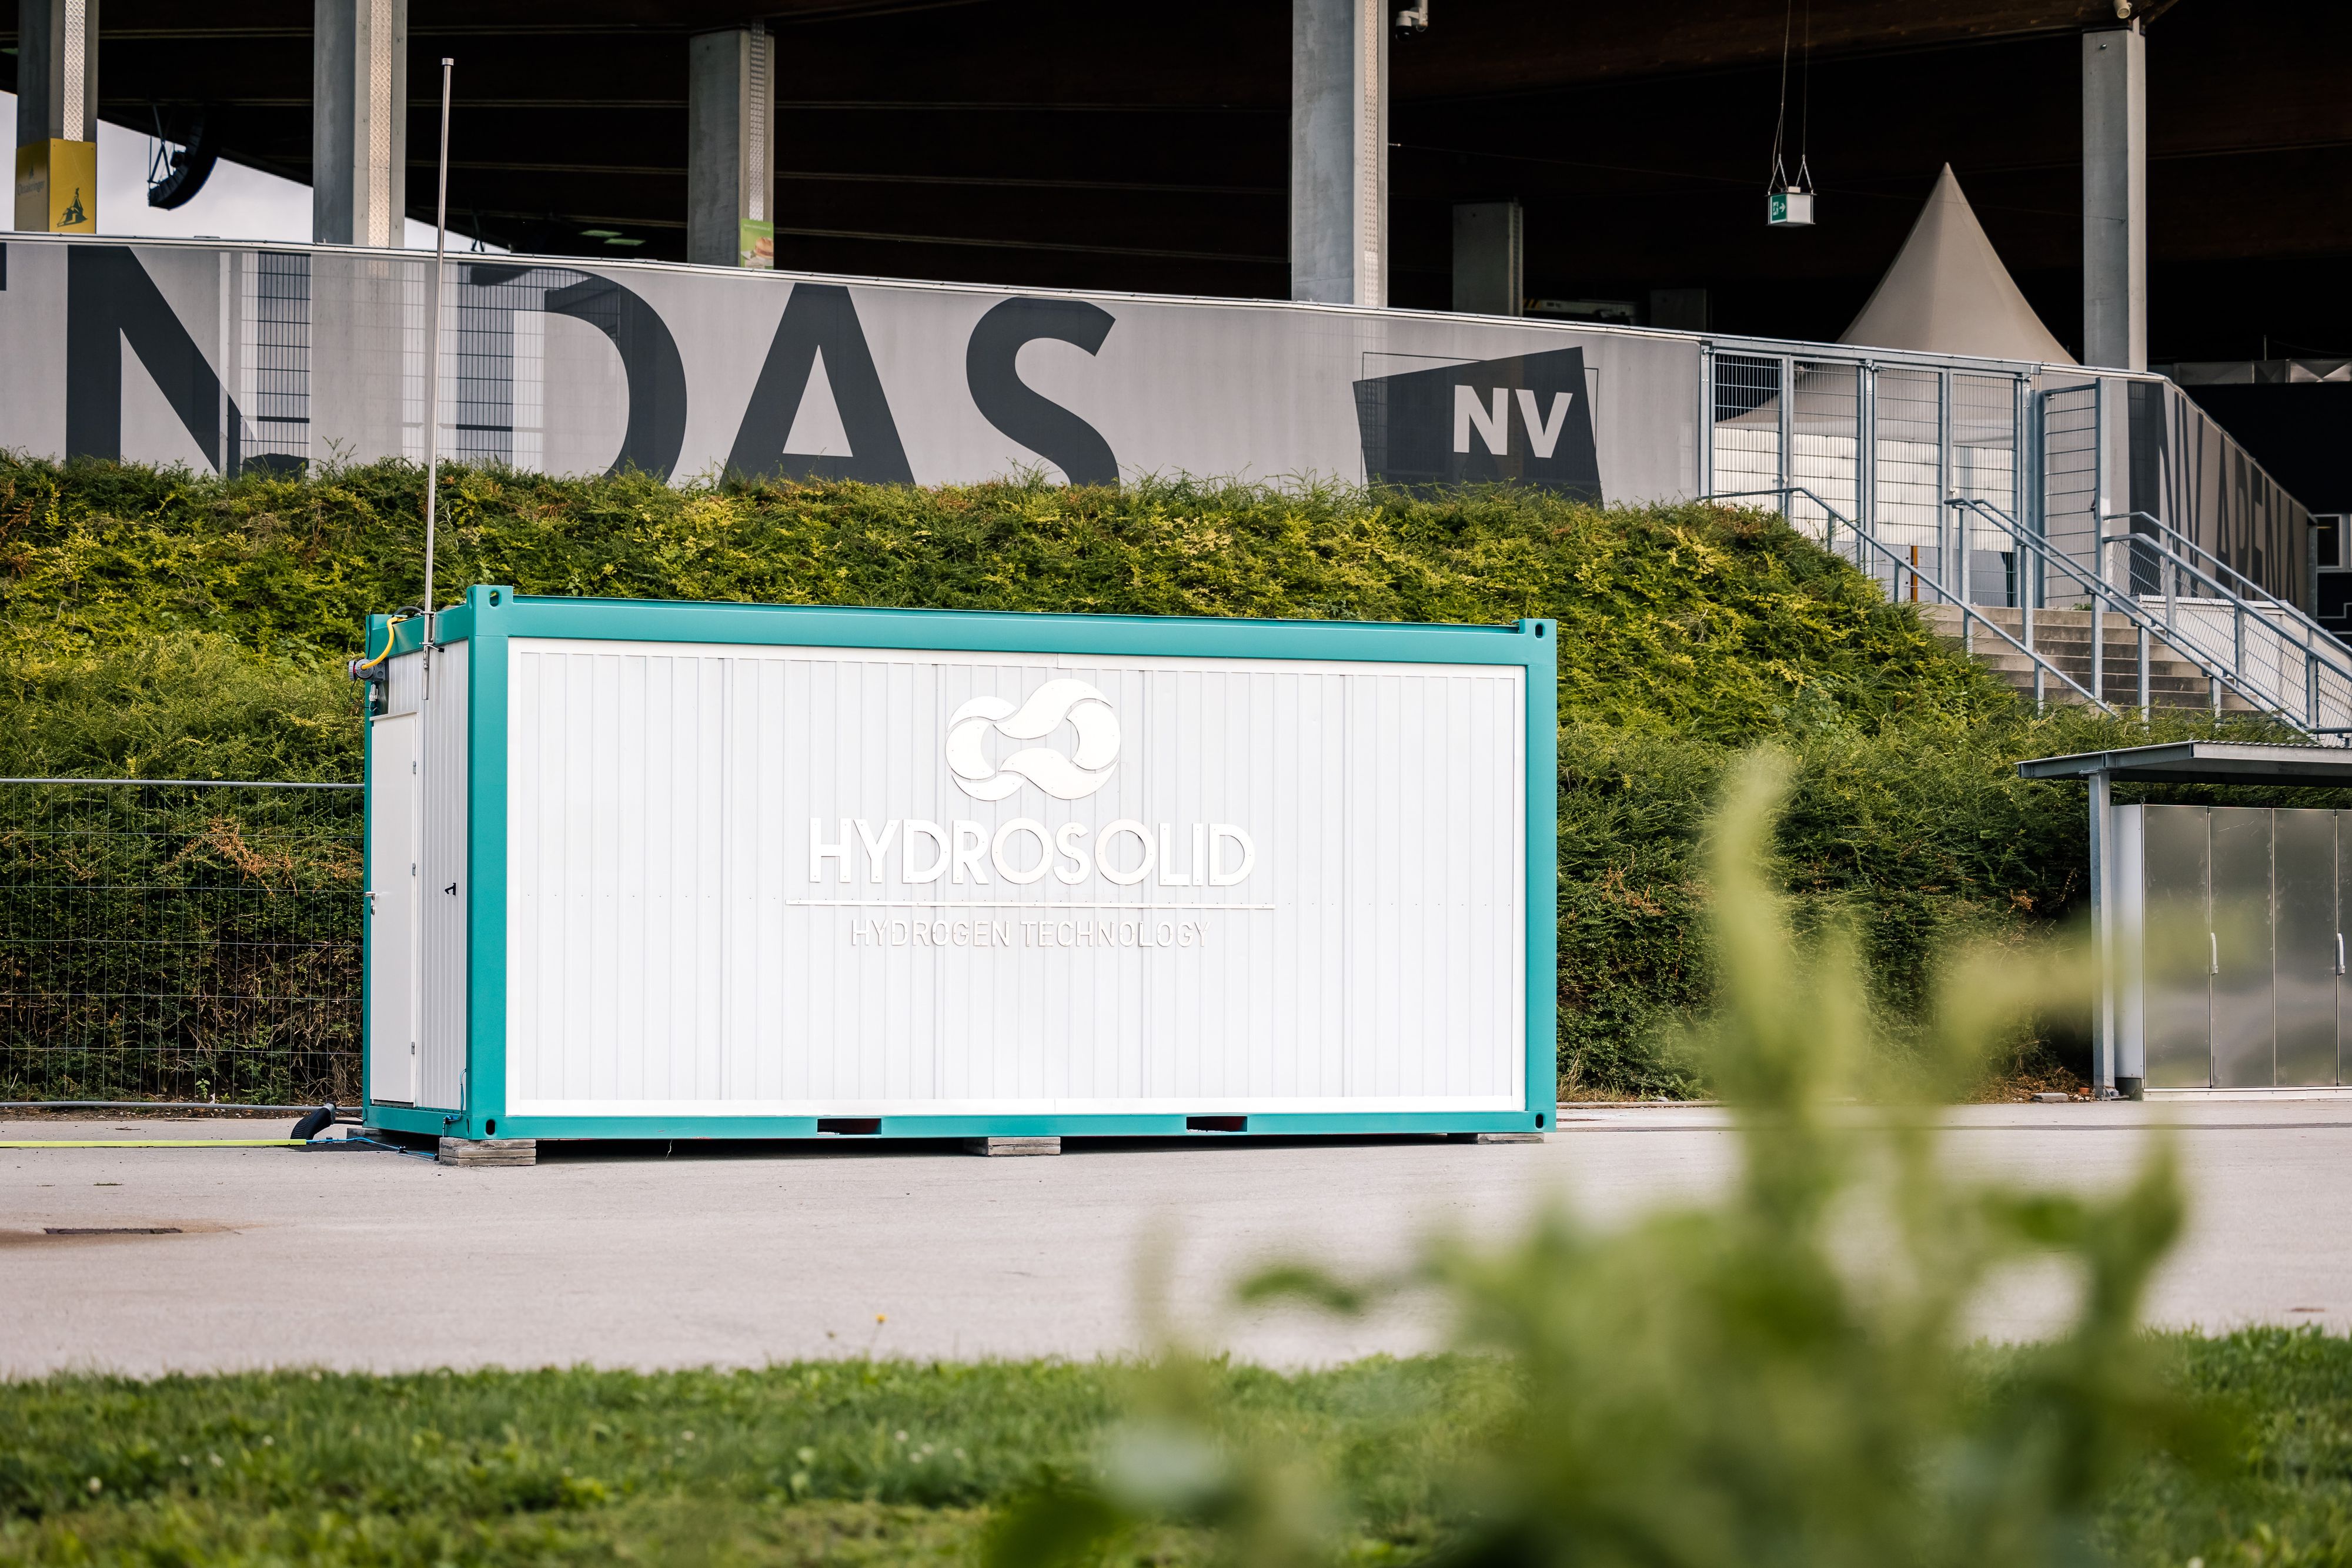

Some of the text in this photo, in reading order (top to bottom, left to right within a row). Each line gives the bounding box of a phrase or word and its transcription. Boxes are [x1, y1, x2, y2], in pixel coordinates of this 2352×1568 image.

[457, 262, 1120, 489] DAS
[1454, 385, 1573, 458] NV
[809, 817, 1255, 886] HYDROSOLID
[852, 919, 1211, 947] HYDROGEN TECHNOLOGY
